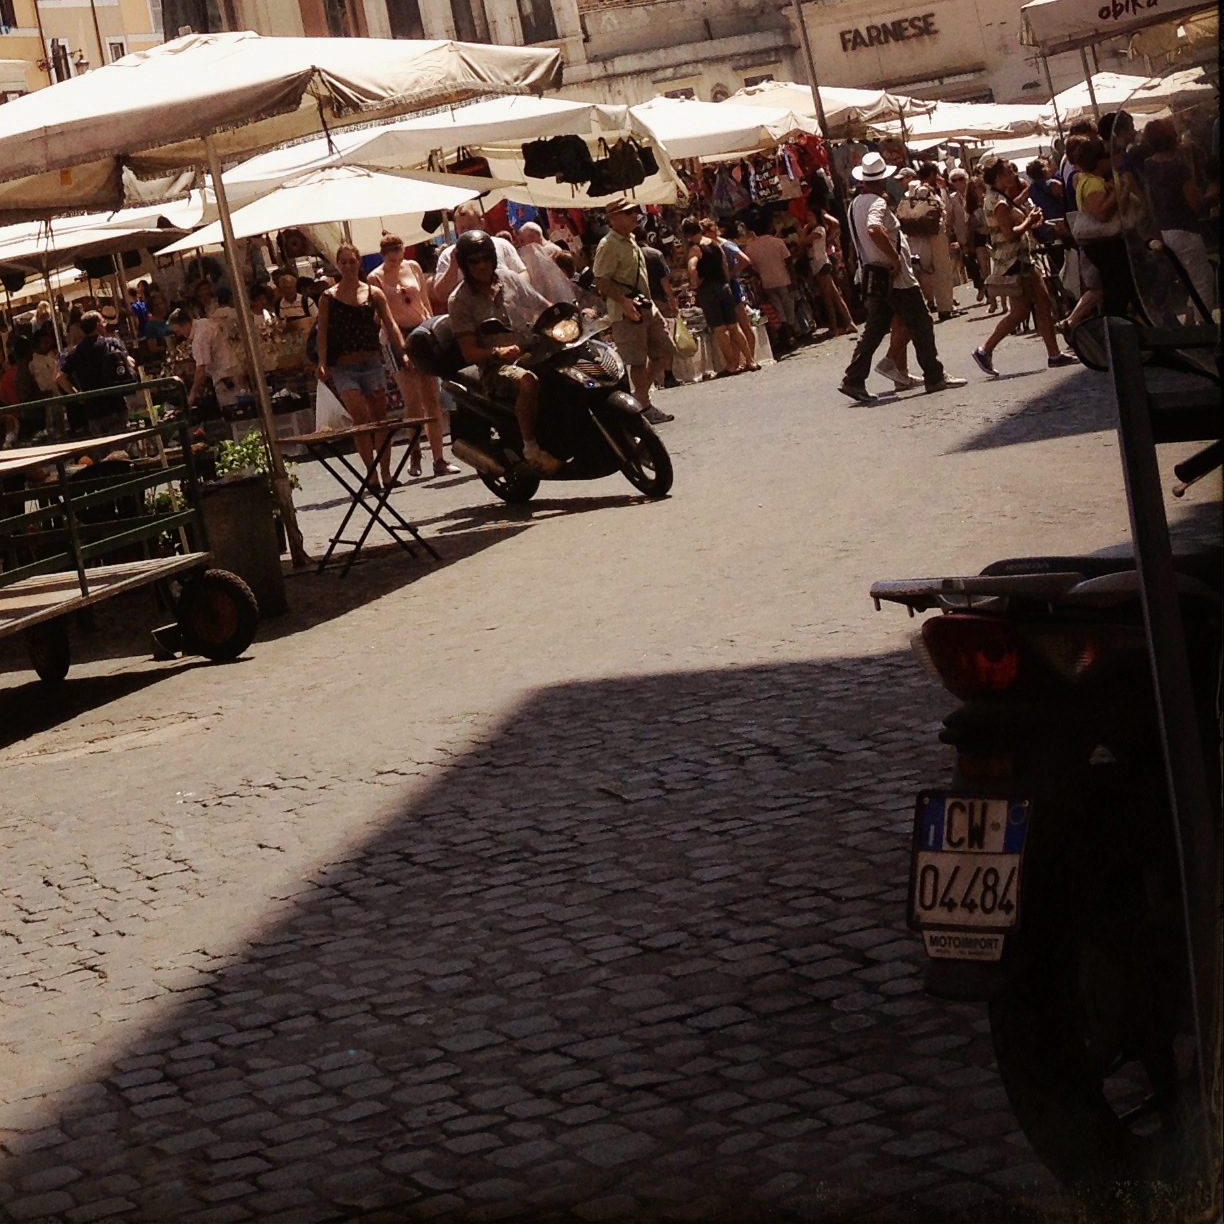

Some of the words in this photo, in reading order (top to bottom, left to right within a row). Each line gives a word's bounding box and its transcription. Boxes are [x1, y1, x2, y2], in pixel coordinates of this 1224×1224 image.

[839, 12, 940, 53] FARNESE
[946, 801, 989, 849] CW
[918, 864, 1017, 915] 04484
[929, 935, 999, 950] MOTOIMPORT
